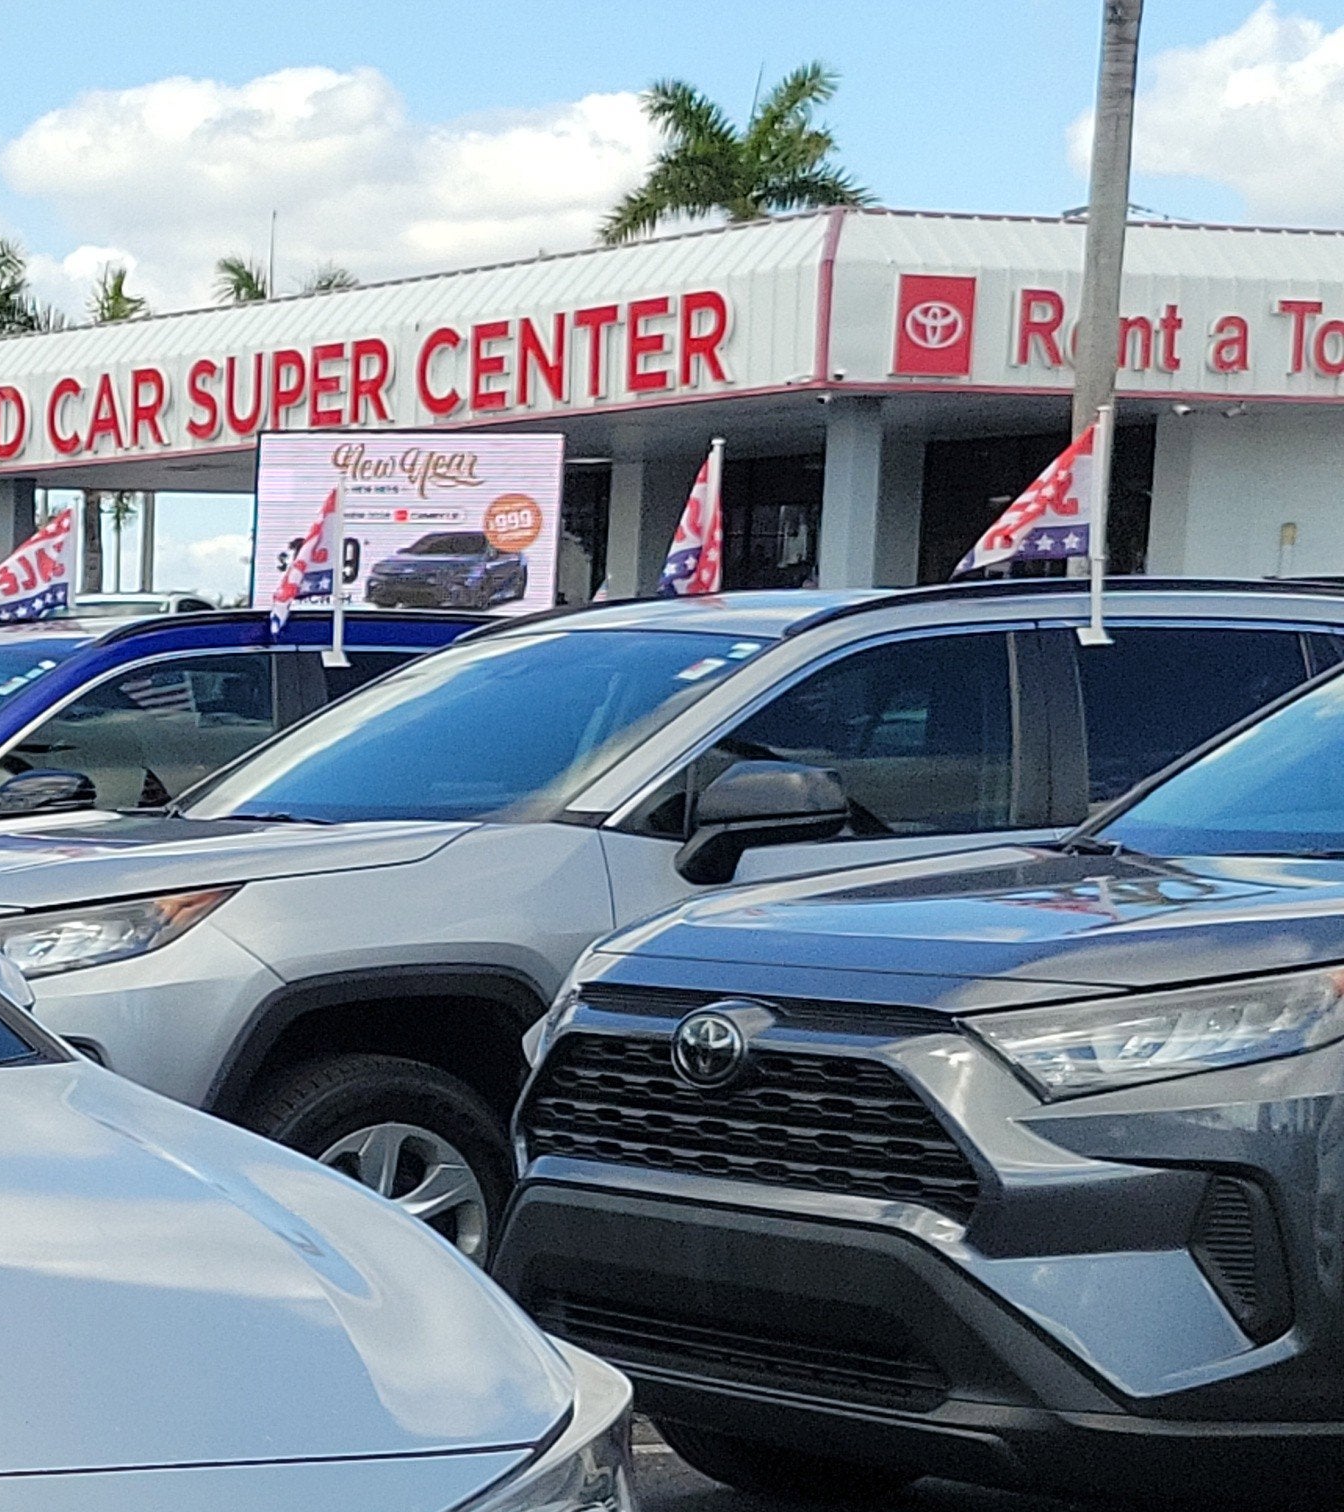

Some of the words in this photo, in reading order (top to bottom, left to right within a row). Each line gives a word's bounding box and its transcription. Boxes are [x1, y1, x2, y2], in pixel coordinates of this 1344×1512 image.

[46, 367, 168, 455] CAR
[185, 337, 393, 440] SUPER
[416, 290, 730, 417] CENTER
[1016, 288, 1183, 372] Rnt
[1213, 315, 1249, 372] a
